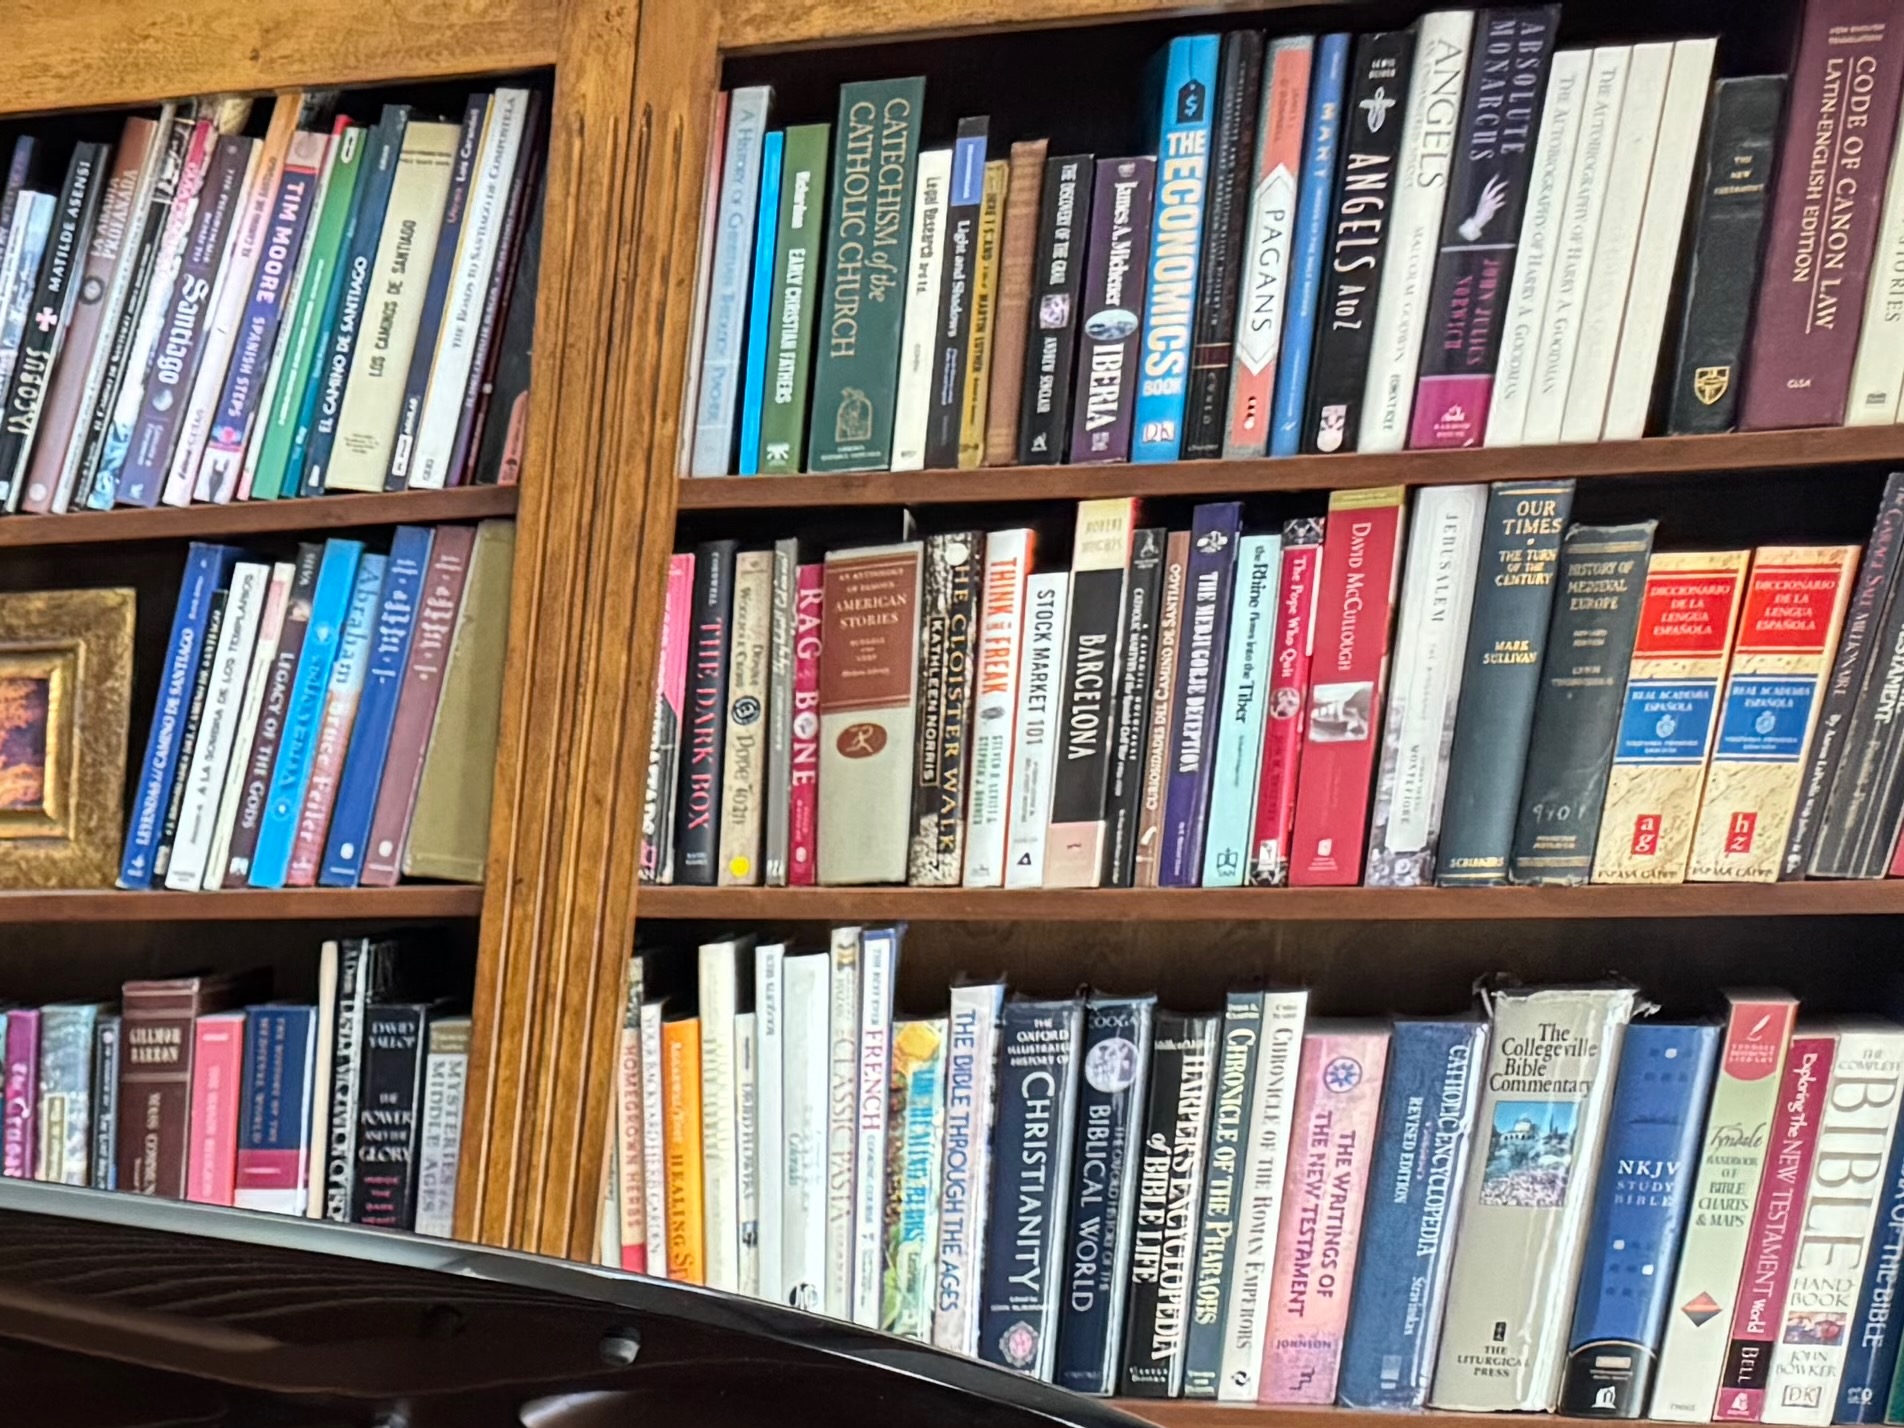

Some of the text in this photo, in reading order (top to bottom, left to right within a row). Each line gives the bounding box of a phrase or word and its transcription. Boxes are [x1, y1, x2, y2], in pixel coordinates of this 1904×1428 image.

[1417, 40, 1463, 190] ANGELS
[1470, 19, 1516, 162] MONARCHS
[1501, 22, 1546, 154] ABSOLUTE
[874, 97, 910, 246] CATECHISM
[1167, 131, 1207, 156] THE
[1792, 58, 1844, 283] LATIN-ENGLISH EDITION
[831, 100, 876, 359] CATHOLIC CHURCH
[1815, 56, 1877, 331] CODE OF CANON LAW
[256, 180, 304, 305] TIM MOORE
[1144, 158, 1206, 380] ECONOMICS
[1251, 209, 1286, 333] PAGANS
[157, 274, 210, 385] Santiago
[339, 255, 368, 331] SANTIAGO
[1086, 343, 1124, 430] IBERIA
[1502, 517, 1563, 536] TIMES
[1516, 499, 1557, 517] OUR
[834, 593, 908, 614] AMERICAN
[989, 556, 1018, 616] THINK
[1430, 512, 1459, 623] JERUSALEM
[1495, 571, 1554, 587] CENTURY
[796, 587, 823, 660] RAG
[839, 613, 899, 628] STORIES
[1033, 588, 1056, 643] STOCK
[982, 634, 1012, 696] FREAK
[1027, 644, 1051, 715] MARKET
[1068, 633, 1107, 762] BARCELONA
[1482, 651, 1537, 665] SULLIVAN
[686, 618, 722, 831] THE DARK BOX
[923, 618, 945, 782] KATHLEEN NORRIS
[1500, 1037, 1598, 1060] Collegeville
[1503, 1057, 1548, 1078] Bible
[1537, 1022, 1572, 1043] The
[861, 1029, 884, 1133] FRENCH
[1216, 1028, 1257, 1144] CHRONICLE
[1489, 1073, 1594, 1098] Commentary
[939, 1009, 977, 1312] THE BIBLE THROUGH THE AGES
[1316, 1111, 1333, 1147] THE
[1617, 1159, 1681, 1177] NKJV
[1007, 1070, 1056, 1299] CHRISTIANITY
[1071, 1103, 1111, 1313] BIBLICAL WORLD
[1140, 1154, 1171, 1226] BIBLE
[1316, 1130, 1356, 1300] THE WRITINGS OF
[1697, 1197, 1750, 1213] CHARTS
[1796, 1077, 1897, 1273] BIBLE
[1131, 1228, 1164, 1285] LIFE
[1288, 1202, 1316, 1319] TESTAMENT
[1709, 1214, 1746, 1228] MAPS
[1194, 1220, 1235, 1326] PHARAOHS
[1790, 1292, 1850, 1308] BOOK
[1737, 1346, 1760, 1383] BELL
